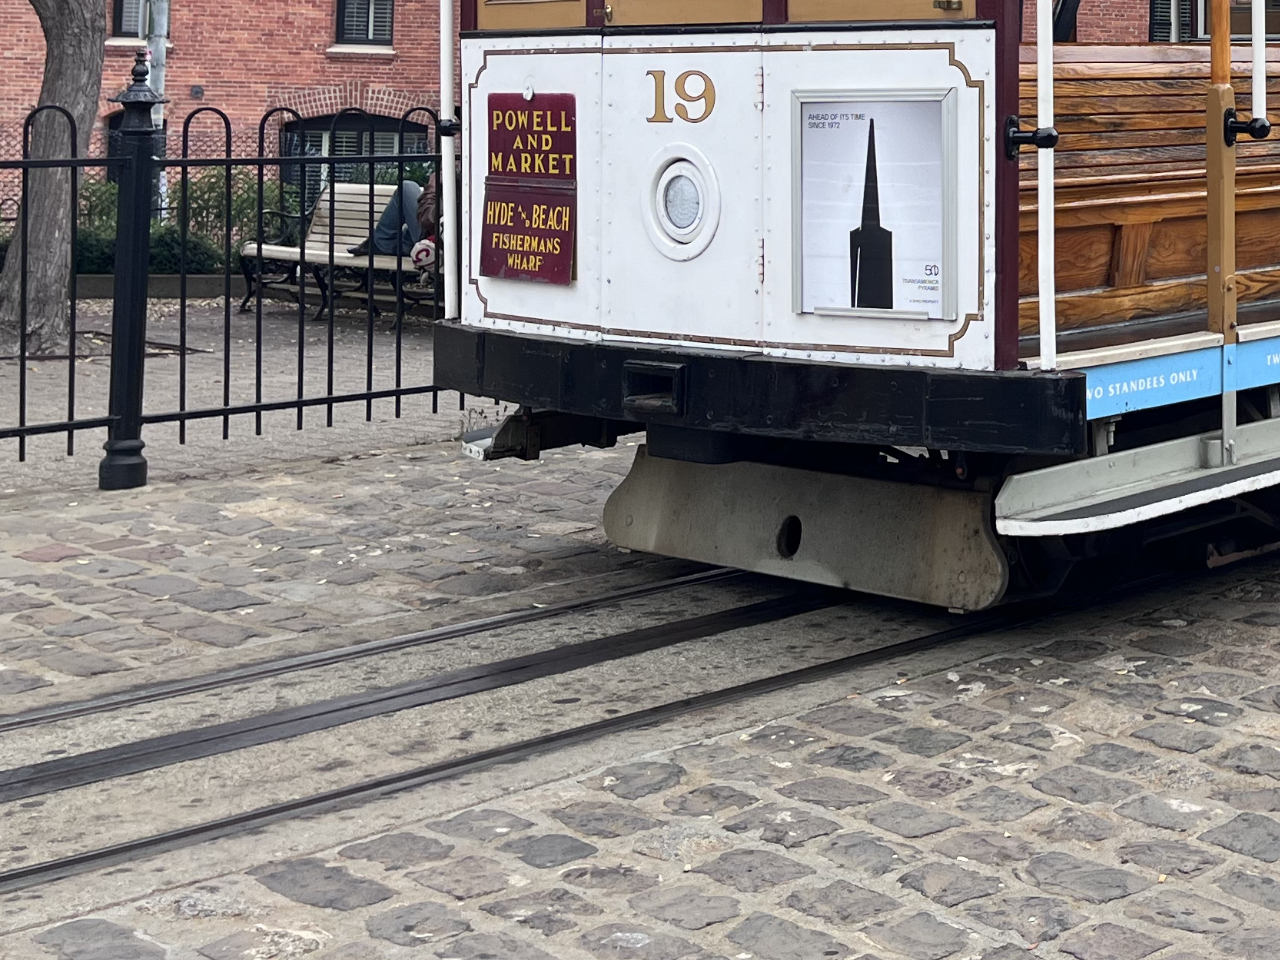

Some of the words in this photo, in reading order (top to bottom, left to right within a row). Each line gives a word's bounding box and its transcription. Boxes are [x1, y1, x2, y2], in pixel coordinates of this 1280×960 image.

[645, 69, 716, 123] 19
[492, 109, 571, 132] POWELL
[807, 113, 829, 121] AHEAD
[807, 121, 826, 129] SINCE
[827, 121, 840, 129] 1972
[513, 134, 552, 151] AND
[491, 152, 574, 175] MARKET
[486, 201, 515, 227] HYDE
[532, 204, 570, 232] BEACH
[491, 232, 561, 255] FISHERMANS
[507, 253, 543, 271] WHARF
[1086, 386, 1103, 400] WO
[1108, 375, 1165, 397] STANDEES
[1170, 368, 1198, 385] ONLY
